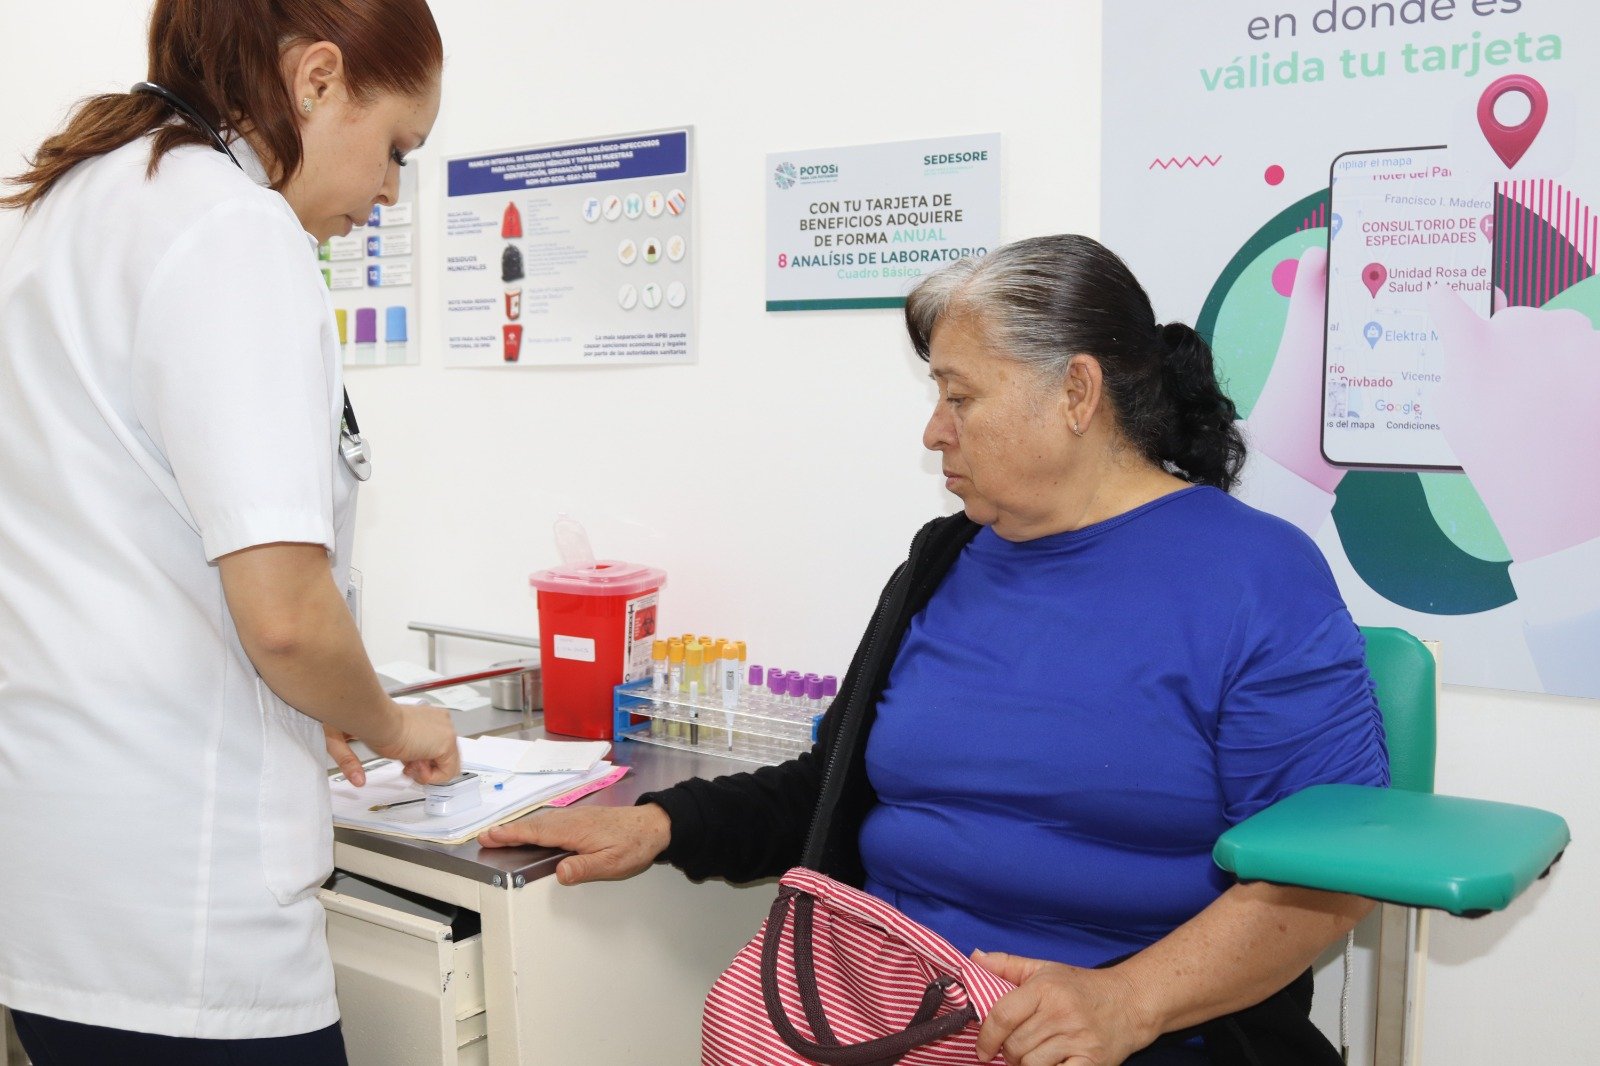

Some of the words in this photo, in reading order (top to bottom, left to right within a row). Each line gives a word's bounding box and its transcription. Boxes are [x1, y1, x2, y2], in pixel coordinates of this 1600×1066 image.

[1247, 13, 1297, 40] en
[1312, 0, 1456, 34] donde
[1471, 0, 1522, 16] es
[1200, 51, 1325, 91] válida
[1340, 49, 1386, 79] tu
[1401, 31, 1562, 78] tarjeta
[923, 151, 989, 166] SEDESORE
[1382, 157, 1412, 169] mapa
[809, 202, 840, 215] CON
[844, 200, 862, 213] TU
[866, 195, 928, 211] TARJETA
[932, 193, 952, 207] DE
[1385, 194, 1436, 206] Francisco
[1450, 197, 1492, 209] Madero
[799, 215, 882, 231] BENEFICIOS
[886, 209, 963, 226] ADQUIERE
[1362, 219, 1455, 233] CONSULTORIO
[1459, 218, 1477, 229] DE
[814, 235, 832, 247] DE
[836, 232, 888, 246] FORMA
[892, 228, 947, 244] ANUAL
[1366, 232, 1476, 247] ESPECIALIDADES
[777, 253, 788, 269] 8
[791, 251, 854, 269] ANALÍSIS
[858, 252, 877, 265] DE
[837, 268, 879, 280] Cuadro
[1389, 266, 1432, 279] Unidad
[1436, 266, 1467, 279] Rosa
[1471, 265, 1487, 278] de
[1389, 281, 1423, 293] Salud
[1385, 331, 1427, 342] Elektra
[1329, 363, 1344, 373] rio
[1402, 371, 1442, 383] Vicente
[1375, 399, 1421, 414] Google
[1336, 420, 1349, 428] del
[1351, 421, 1375, 430] mapa
[1386, 421, 1440, 430] Condiciones
